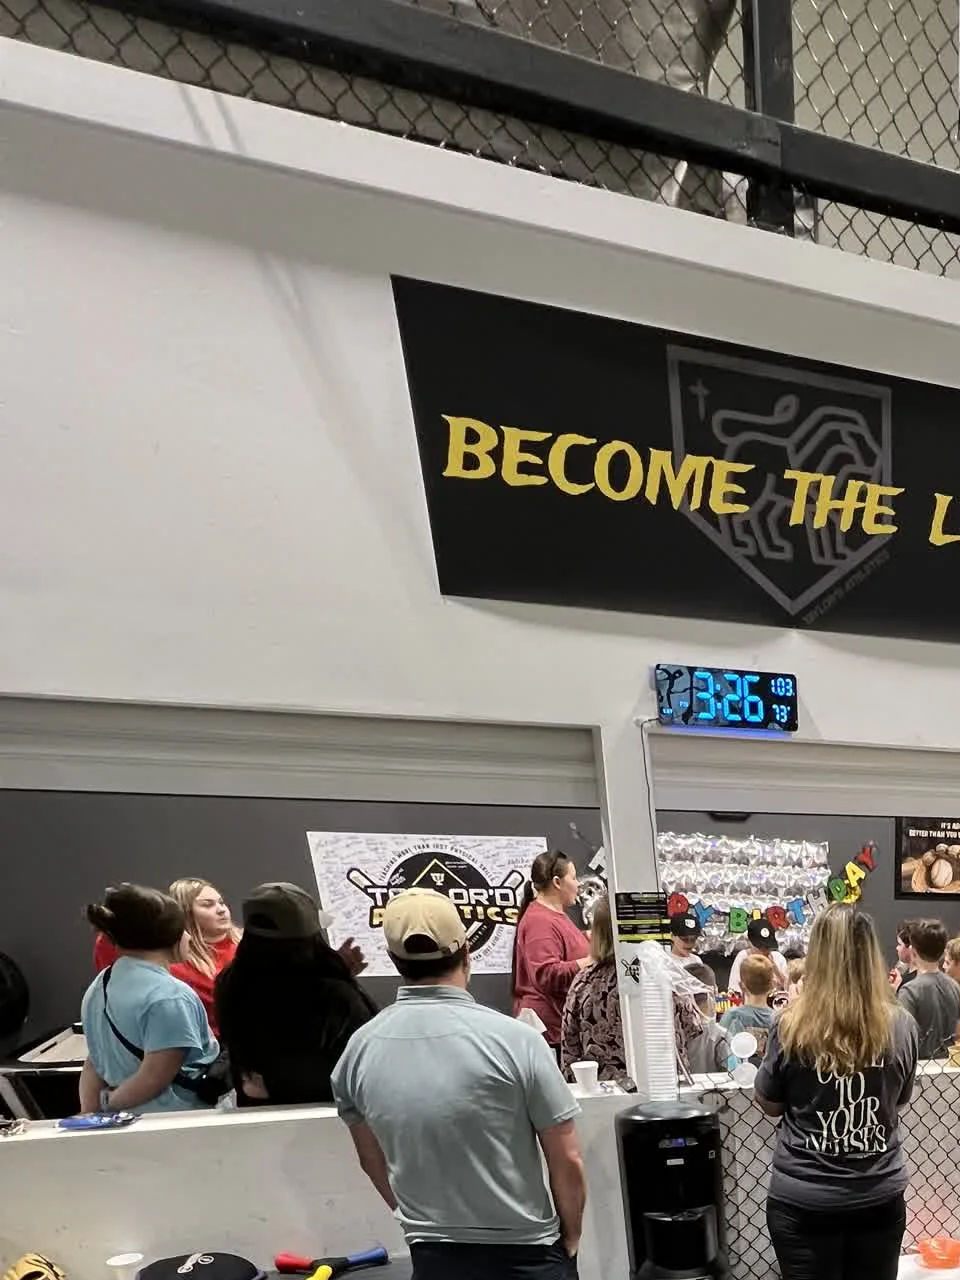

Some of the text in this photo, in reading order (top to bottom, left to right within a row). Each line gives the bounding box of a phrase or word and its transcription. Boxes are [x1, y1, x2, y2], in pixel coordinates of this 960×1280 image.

[441, 414, 756, 515] BECOME
[784, 469, 906, 535] THE
[694, 672, 764, 723] 3:26
[413, 843, 430, 851] THAN
[450, 845, 478, 864] PHYSICAL
[908, 829, 929, 837] BETTER
[929, 830, 946, 838] THAN
[946, 831, 958, 839] YOU
[835, 1071, 865, 1108] TO
[816, 1096, 880, 1139] YOUR
